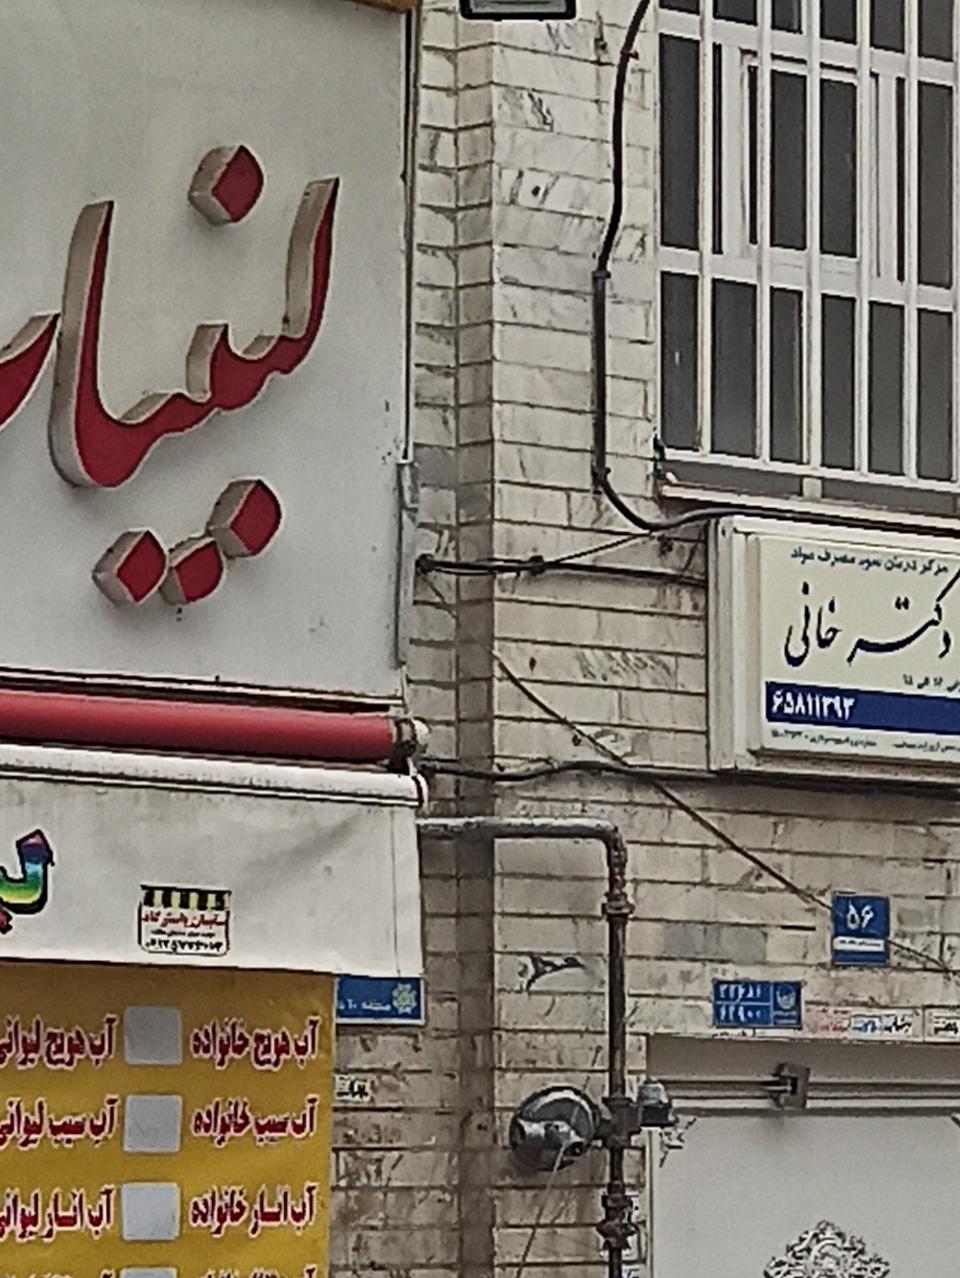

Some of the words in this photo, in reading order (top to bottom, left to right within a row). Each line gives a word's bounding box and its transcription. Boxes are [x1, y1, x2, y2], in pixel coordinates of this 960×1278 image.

[0, 144, 340, 606] لبنیا
[790, 545, 815, 565] مواد
[817, 549, 855, 568] مصرف
[919, 559, 949, 577] مرکز
[784, 581, 843, 667] خانی
[846, 900, 875, 930] ۵۶
[43, 1026, 87, 1071] هویج
[89, 1014, 118, 1068] آب
[190, 1017, 251, 1069] خانواده
[251, 1027, 292, 1071] هویج
[294, 1016, 319, 1069] آب
[47, 1112, 87, 1148] سیب
[88, 1094, 120, 1148] آب
[191, 1097, 252, 1148] خانواده
[252, 1112, 291, 1146] سیب
[290, 1094, 319, 1138] آب
[0, 1187, 41, 1242] لیوان
[40, 1187, 85, 1242] انار
[86, 1184, 115, 1240] آب
[190, 1185, 249, 1238] خانواده
[289, 1182, 318, 1236] آب
